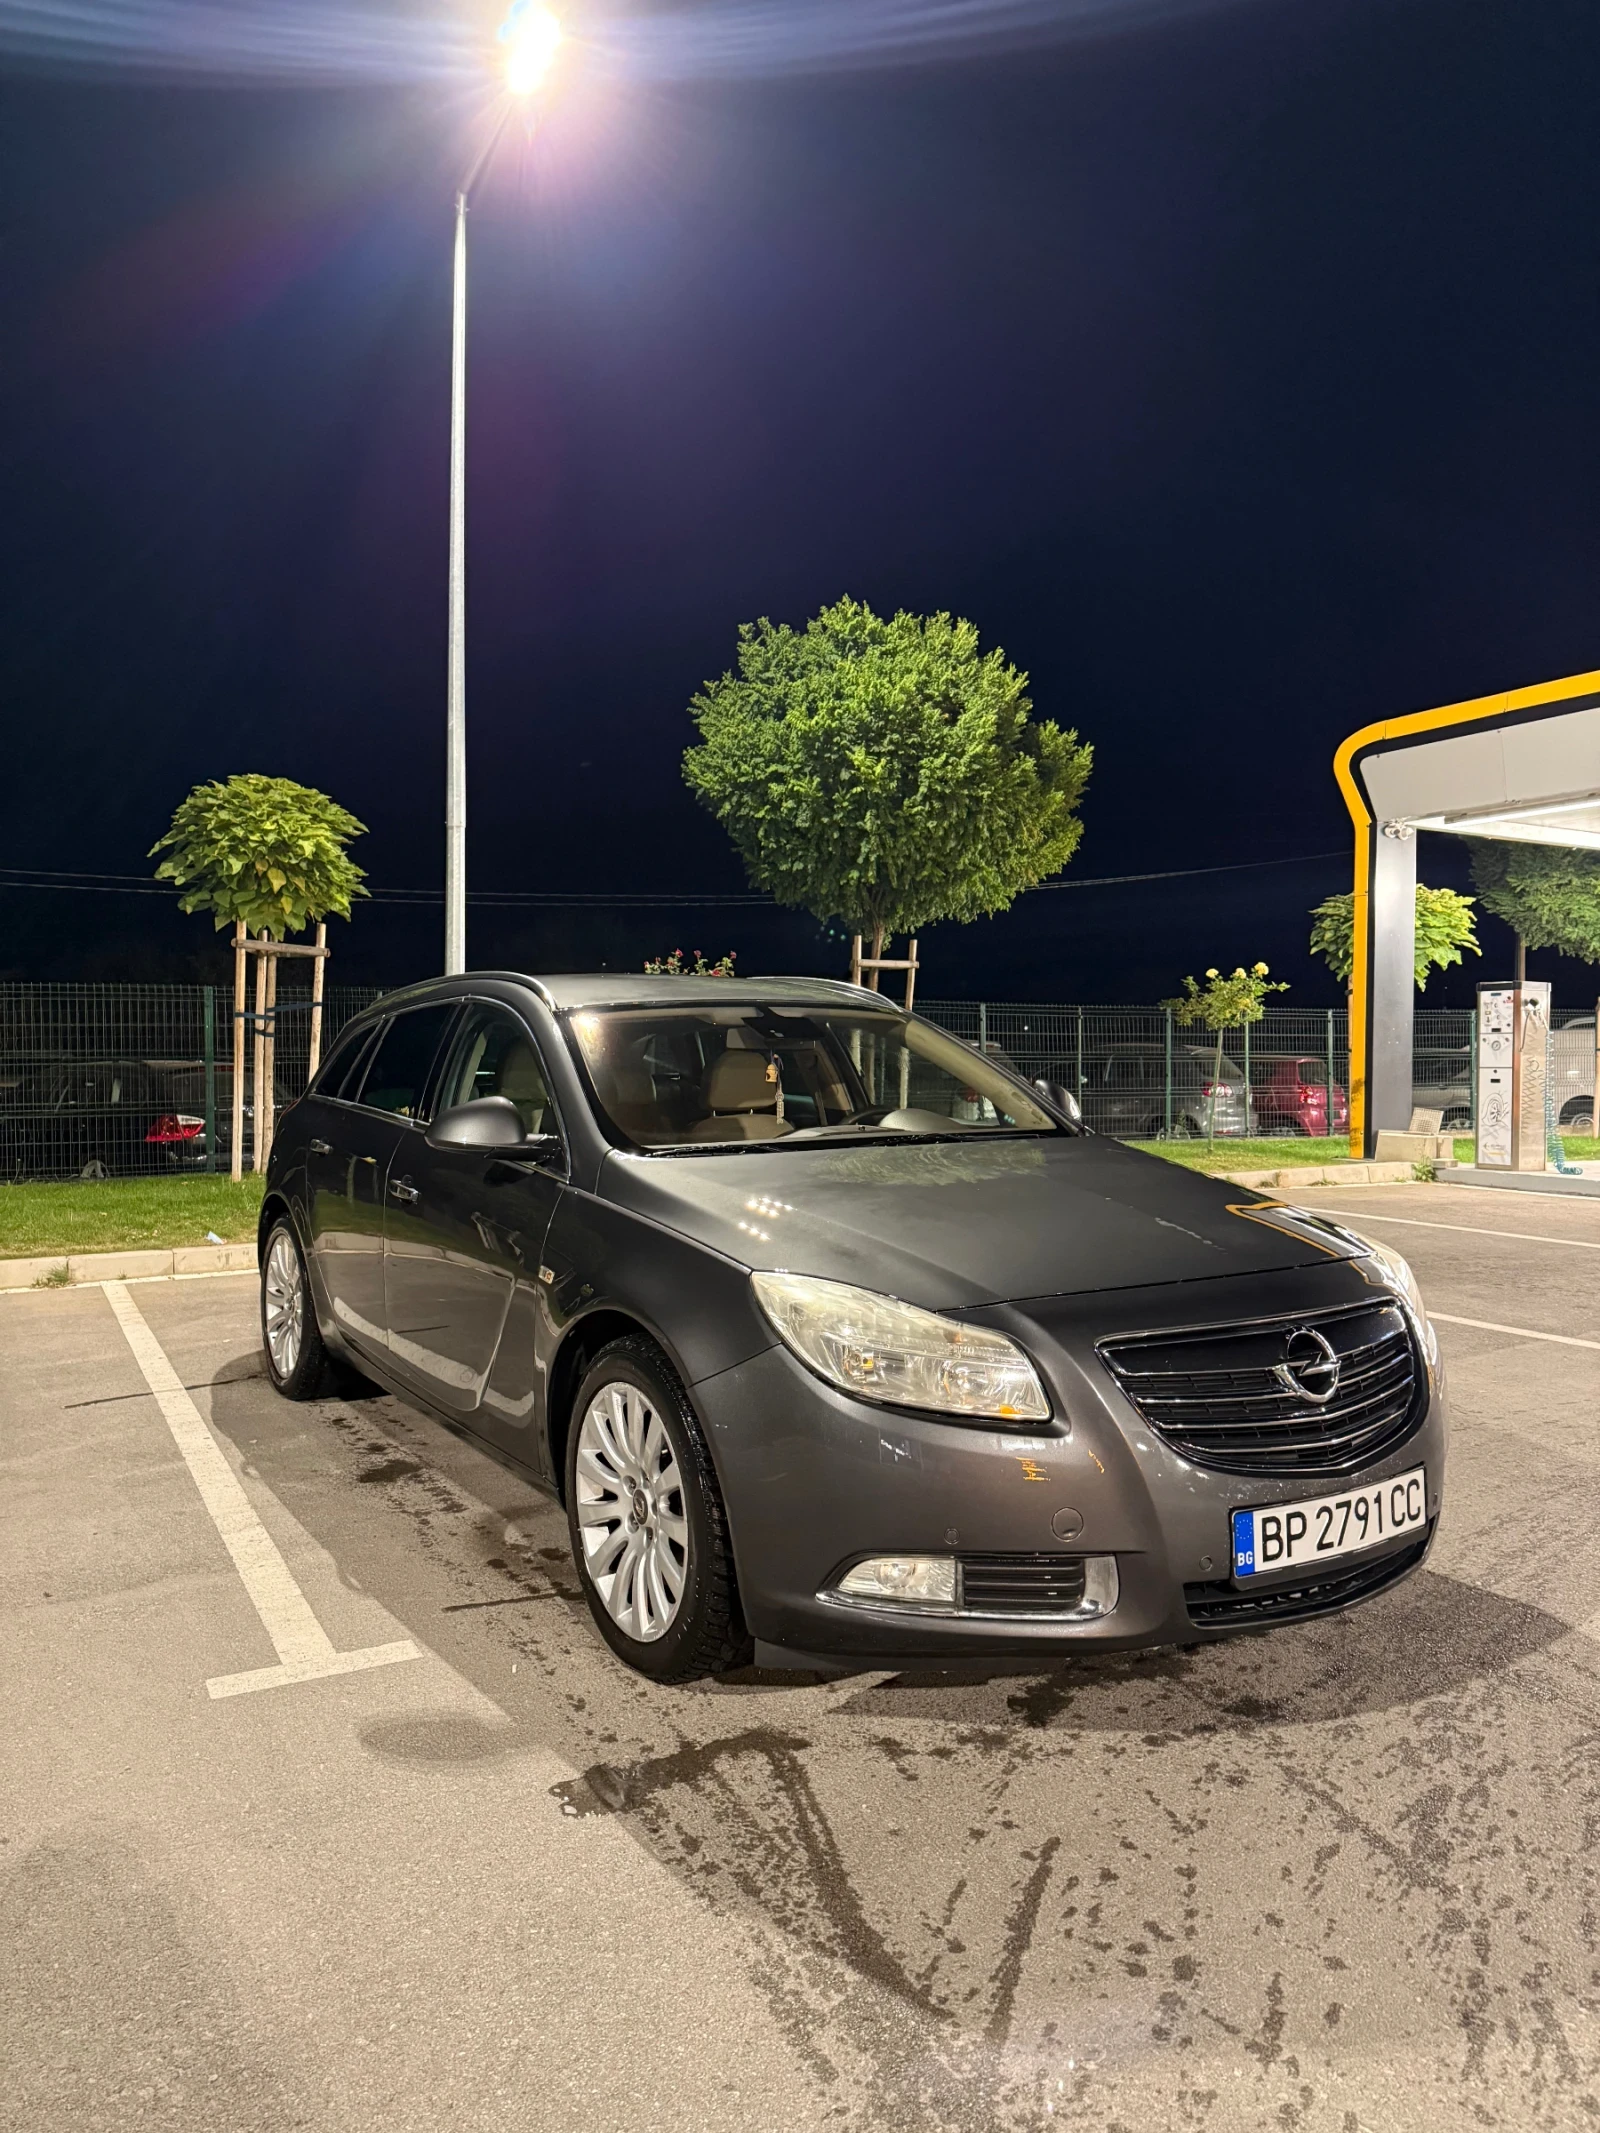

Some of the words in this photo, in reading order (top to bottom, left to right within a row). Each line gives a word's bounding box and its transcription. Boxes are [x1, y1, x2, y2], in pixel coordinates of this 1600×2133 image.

[1261, 1511, 1307, 1563] BP
[1315, 1491, 1382, 1552] 2791
[1390, 1478, 1421, 1528] CC
[1237, 1550, 1254, 1567] BG
